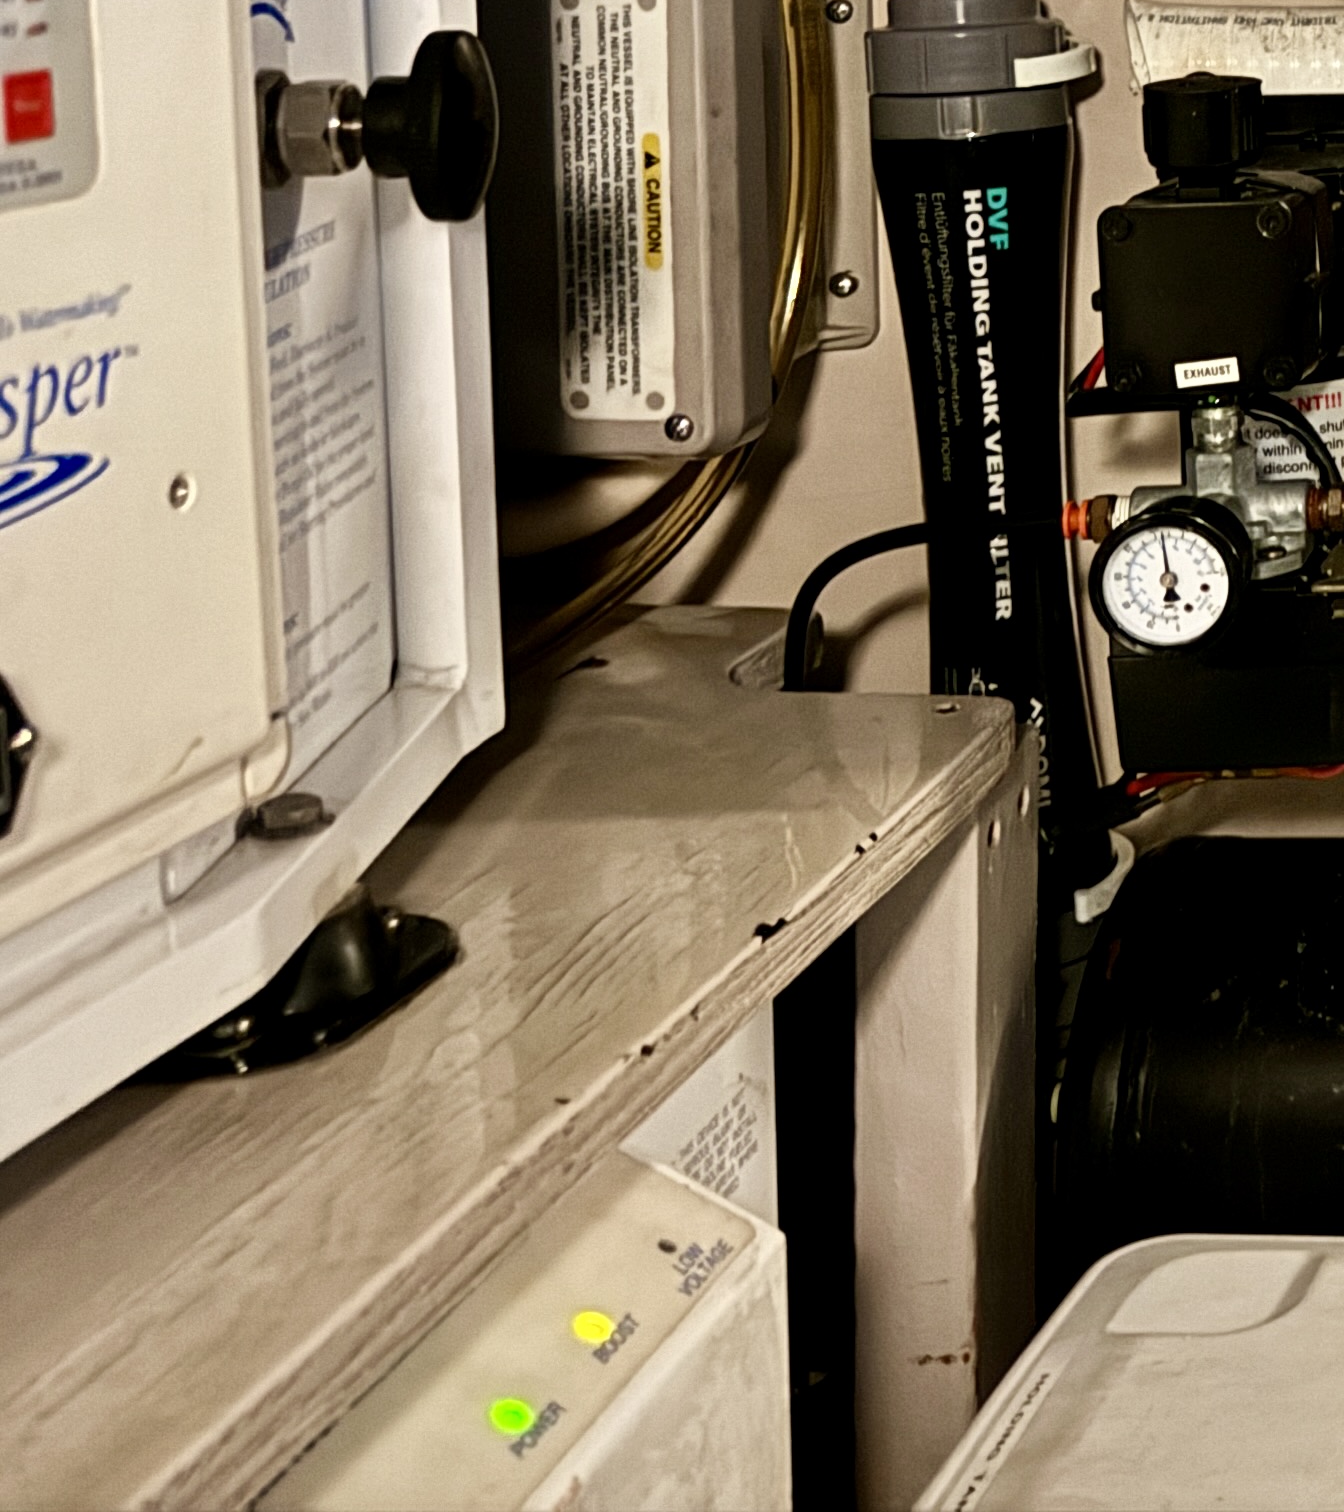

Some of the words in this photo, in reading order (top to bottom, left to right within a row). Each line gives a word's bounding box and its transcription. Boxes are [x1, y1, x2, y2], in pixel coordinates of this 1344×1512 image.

[572, 16, 581, 65] NEUTRAL
[610, 13, 619, 32] THE
[623, 4, 631, 28] THIS
[611, 37, 620, 86] NEUTRAL
[623, 32, 632, 72] VESSEL
[612, 91, 621, 113] AND
[625, 89, 634, 144] EQUIPPED
[588, 139, 598, 205] ELECTRICAL
[613, 117, 623, 183] GROUNDING
[627, 148, 635, 175] WITH
[647, 178, 663, 255] CAUTION
[986, 186, 1009, 251] DVF
[963, 189, 990, 337] HOLDING
[606, 356, 615, 391] PANEL
[976, 340, 1001, 428] TANK
[1183, 364, 1232, 380] EXHAUST
[984, 429, 1006, 515] VENT
[1263, 443, 1303, 457] within
[989, 533, 1013, 621] ILTER
[671, 1242, 705, 1276] LOW
[678, 1237, 735, 1298] VOLTAGE
[591, 1312, 640, 1366] BOOST
[508, 1400, 567, 1459] POWER
